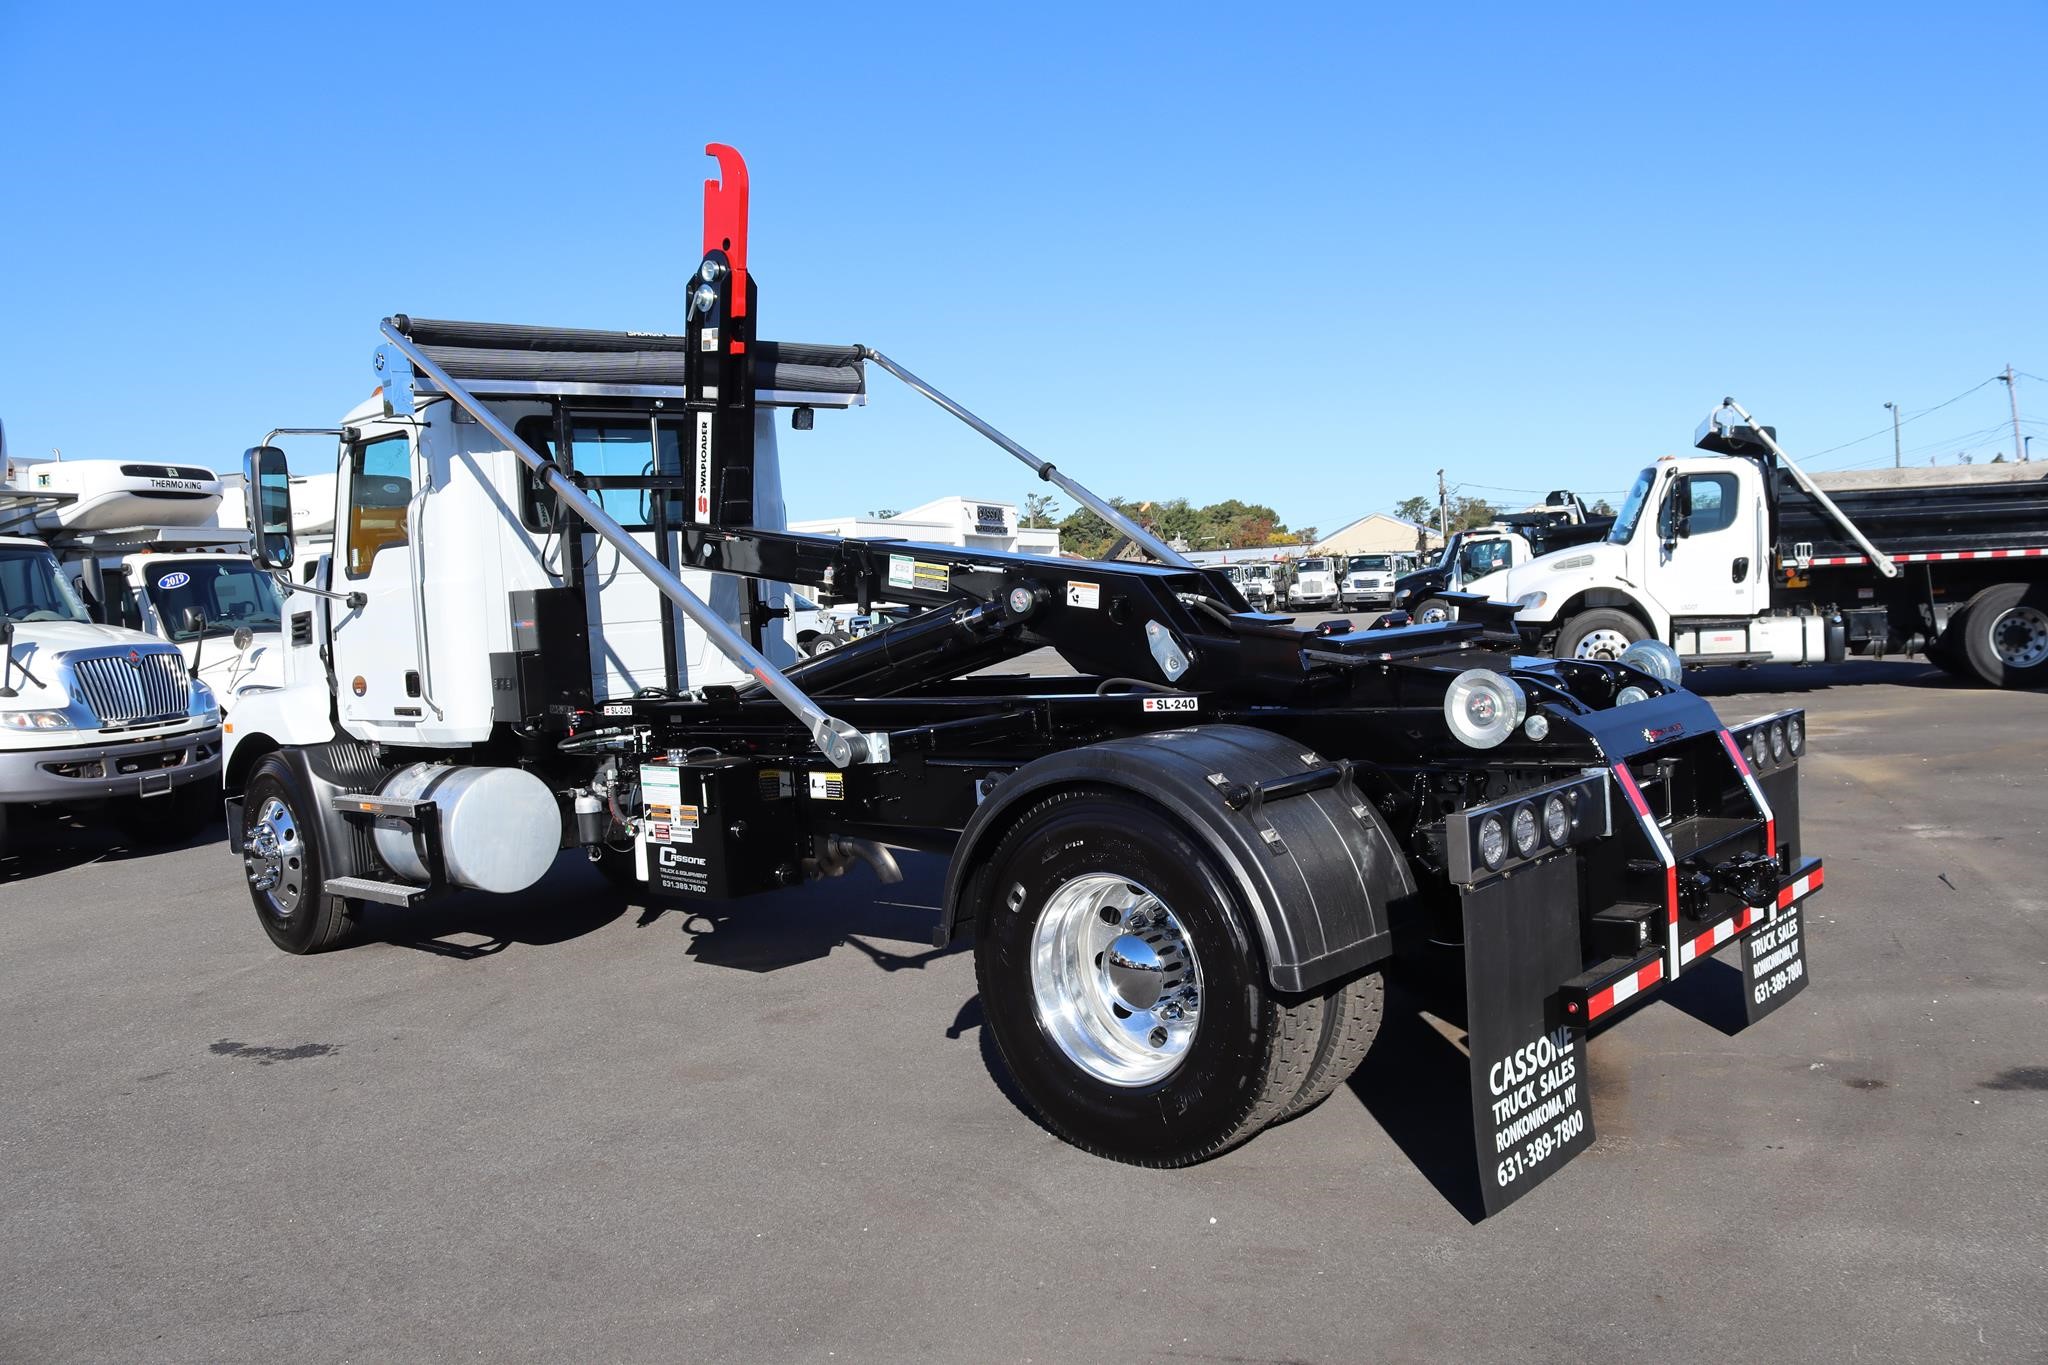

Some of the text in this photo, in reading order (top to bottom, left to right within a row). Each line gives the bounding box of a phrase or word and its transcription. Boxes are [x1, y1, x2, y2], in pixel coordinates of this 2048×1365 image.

[700, 421, 708, 493] SWAPLOADER
[151, 479, 202, 490] THERMO KING
[164, 574, 184, 587] 2019
[611, 706, 630, 715] SL-240
[1156, 699, 1195, 710] SL-240
[1750, 930, 1777, 959] TRUCK
[1777, 918, 1798, 944] SALES
[1791, 938, 1799, 956] NY
[1754, 959, 1803, 1004] 631-389-7800
[1489, 1024, 1574, 1096] CASSONE
[1492, 1056, 1576, 1125] TRUCK SALES
[1495, 1083, 1577, 1153] RONKONKOMA, NY
[1497, 1109, 1584, 1187] 631-389-7800
